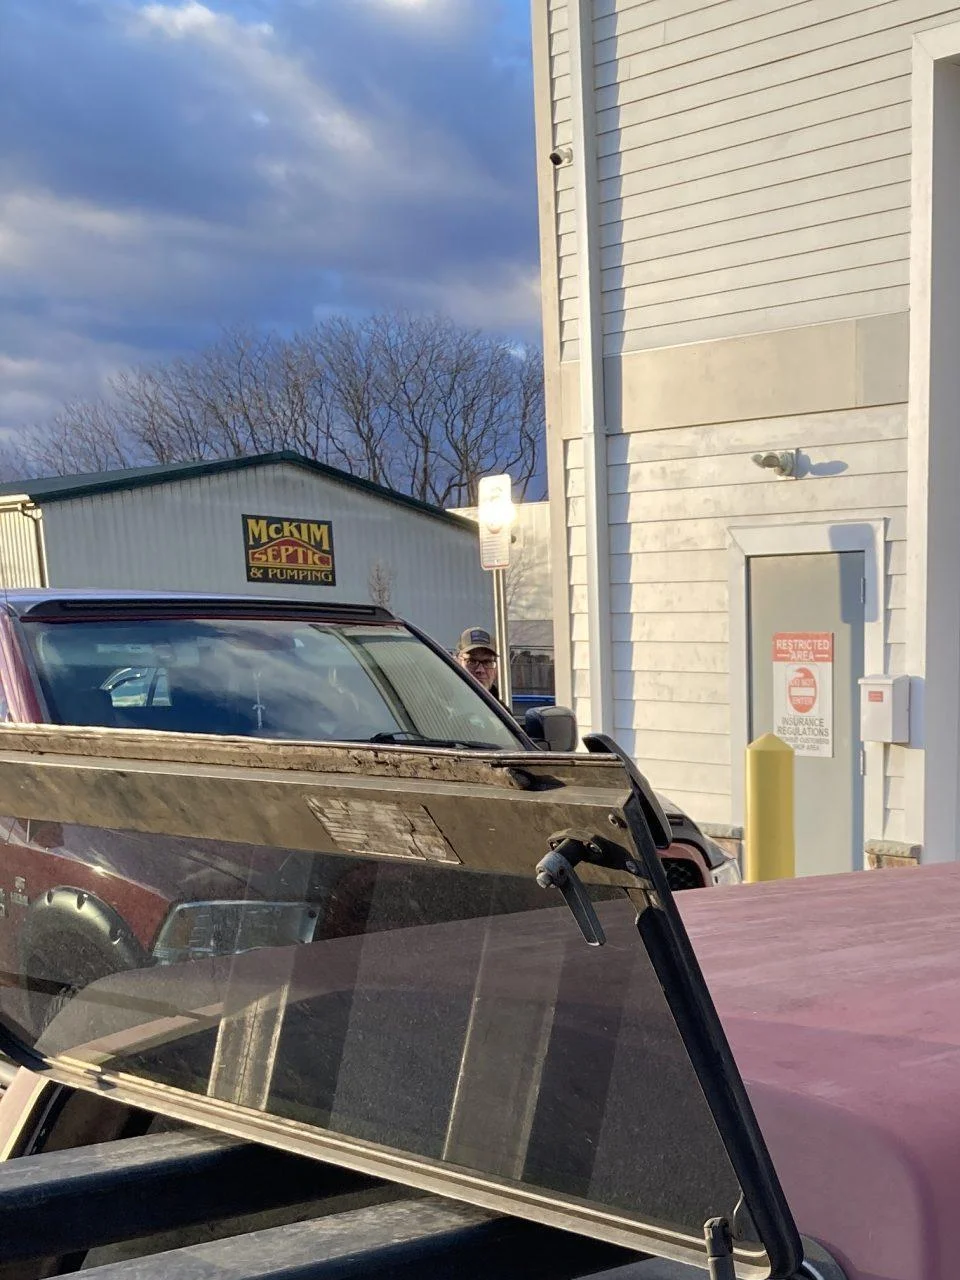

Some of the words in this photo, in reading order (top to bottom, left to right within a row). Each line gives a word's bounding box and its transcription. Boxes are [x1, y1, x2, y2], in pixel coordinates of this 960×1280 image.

[253, 545, 329, 566] SEPTIC
[250, 567, 264, 579] &
[268, 568, 333, 582] PUMPING
[776, 639, 830, 651] RESTRICTED
[790, 650, 815, 661] AREA
[781, 717, 825, 728] INSURANCE
[777, 726, 830, 737] REGULATIONS
